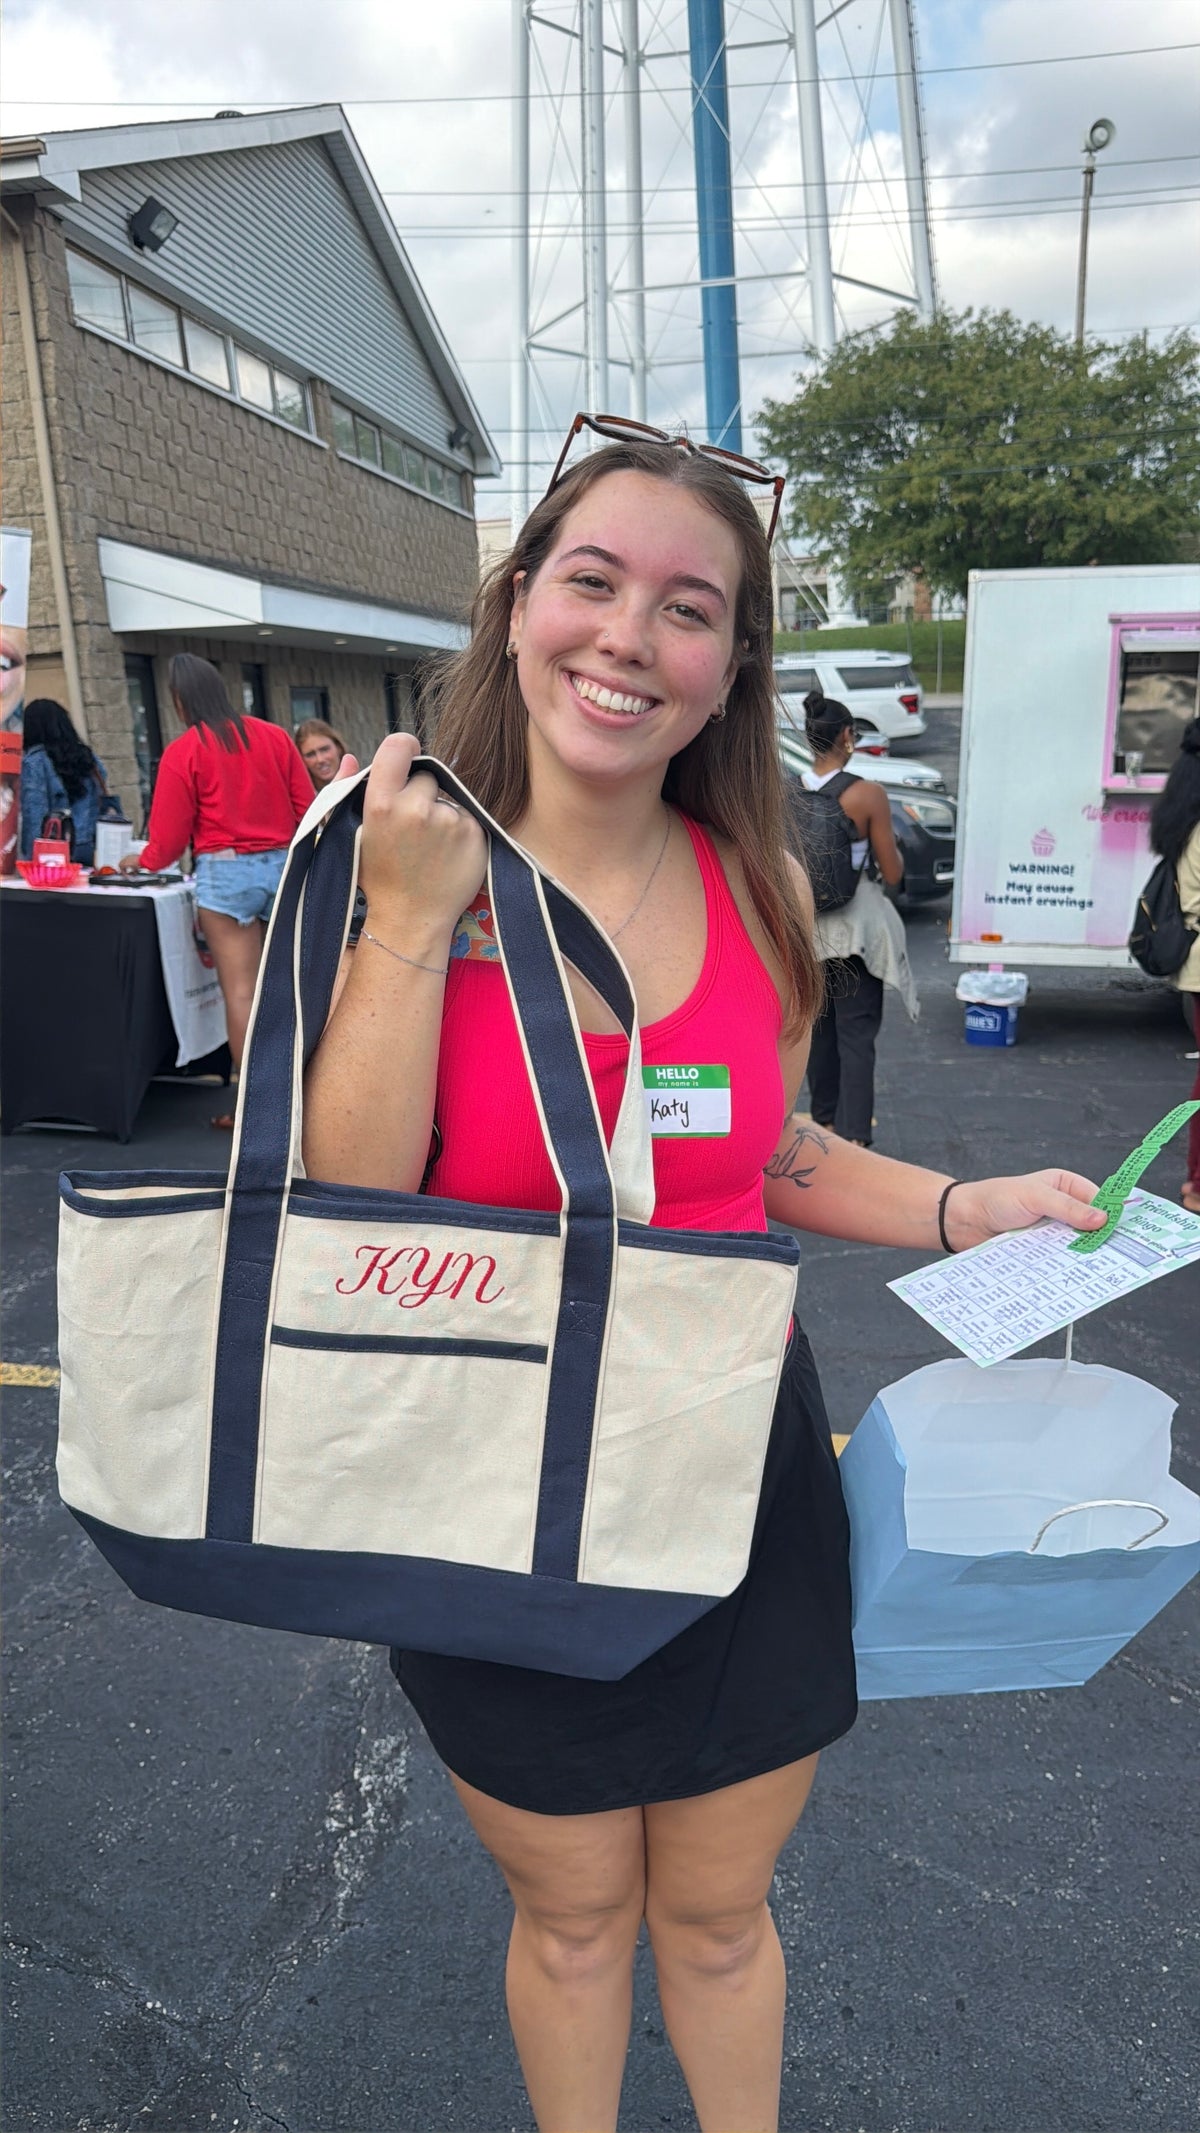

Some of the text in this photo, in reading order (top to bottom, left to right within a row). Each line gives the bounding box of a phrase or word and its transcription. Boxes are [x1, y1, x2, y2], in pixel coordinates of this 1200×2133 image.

[1114, 808, 1150, 824] crea
[1009, 863, 1075, 877] WARNING!
[1006, 881, 1074, 895] May cause
[984, 892, 1094, 911] instant cravings
[656, 1067, 699, 1080] HELLO
[651, 1098, 690, 1128] Katy
[1138, 1198, 1199, 1231] Friendship
[1128, 1214, 1163, 1234] Bingo
